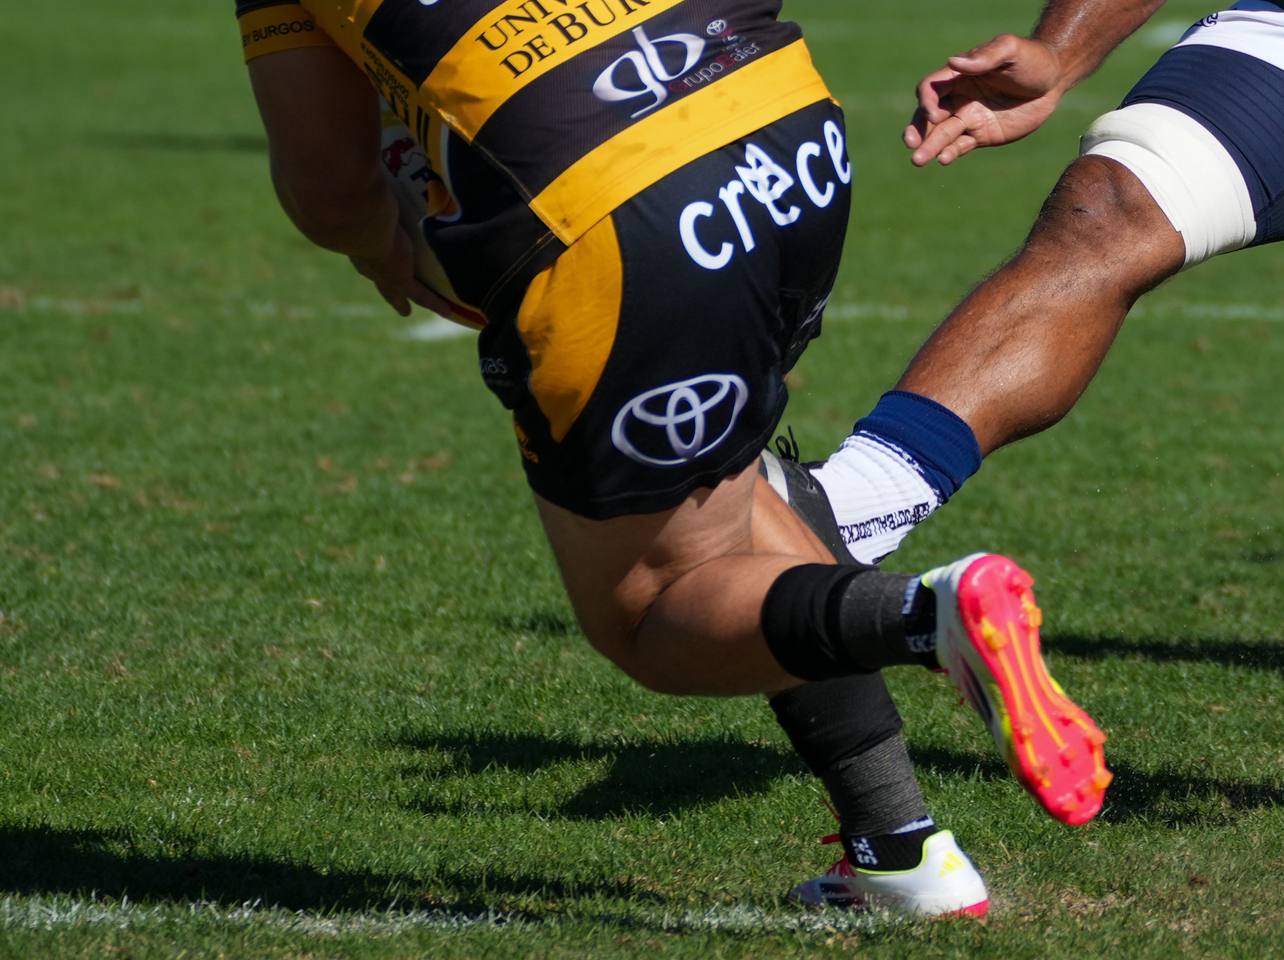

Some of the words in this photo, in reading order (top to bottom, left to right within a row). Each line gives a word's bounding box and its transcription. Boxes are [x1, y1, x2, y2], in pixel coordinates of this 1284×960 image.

[251, 19, 315, 43] BURGOS
[499, 34, 556, 79] DE
[679, 119, 851, 270] crece
